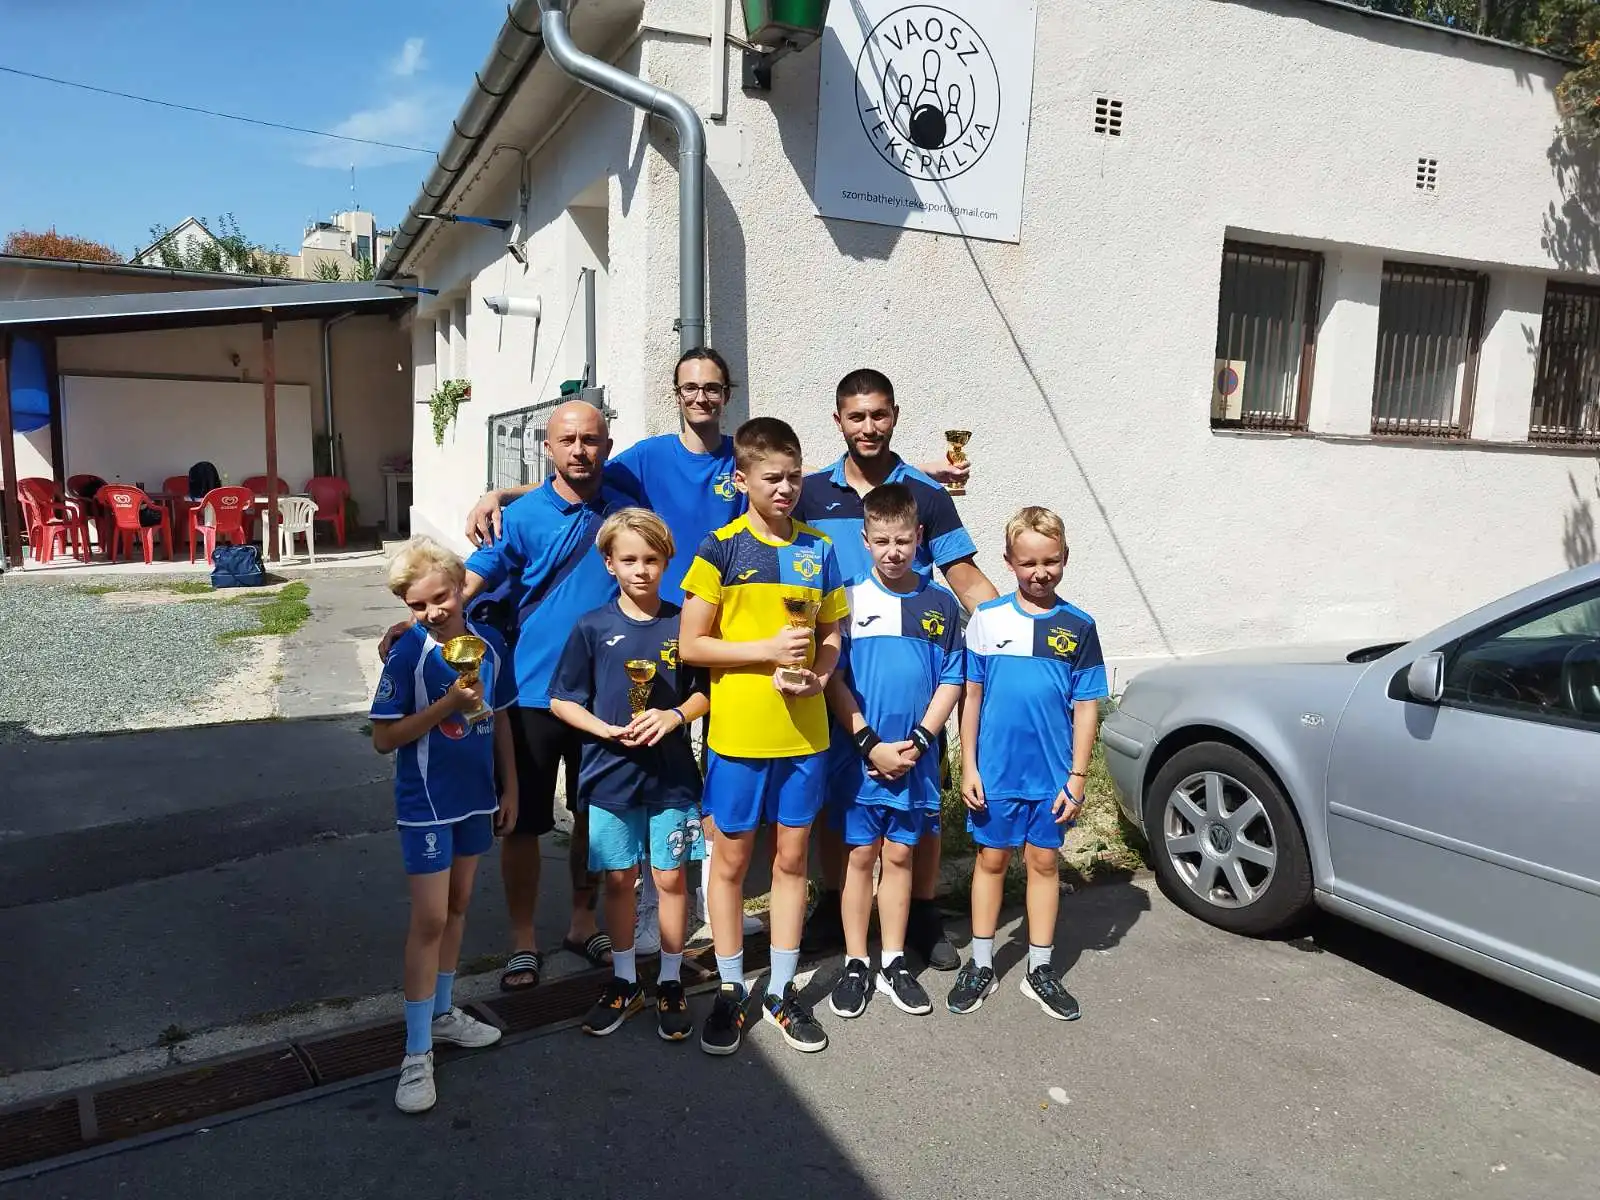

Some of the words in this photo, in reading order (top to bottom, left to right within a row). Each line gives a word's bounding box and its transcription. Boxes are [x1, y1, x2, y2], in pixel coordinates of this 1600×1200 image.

[884, 18, 979, 67] VAOSZ
[865, 100, 991, 174] TEKEPÁLYA
[842, 189, 998, 220] szombathelyi.tekesport@gmail.com
